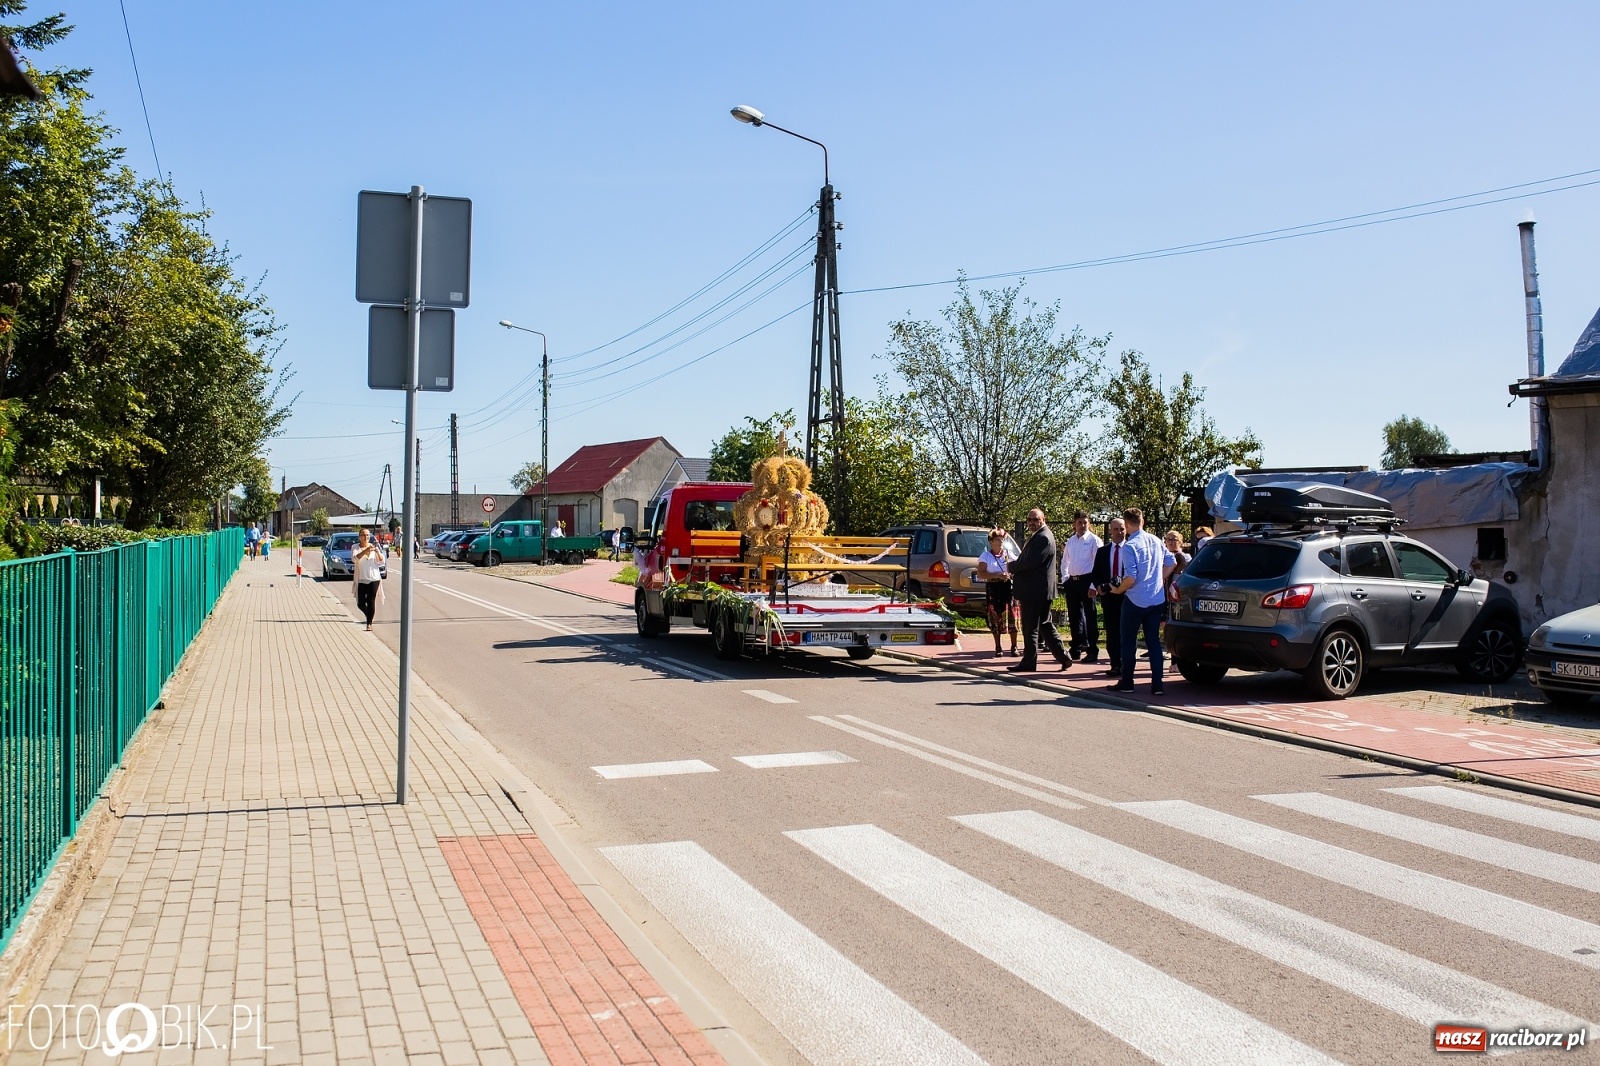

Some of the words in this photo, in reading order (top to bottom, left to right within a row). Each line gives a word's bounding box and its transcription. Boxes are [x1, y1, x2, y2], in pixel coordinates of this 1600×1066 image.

[1199, 600, 1212, 611] SWD
[1214, 602, 1238, 613] 09023
[811, 632, 825, 642] HAM
[829, 632, 838, 642] TP
[839, 632, 852, 641] 444
[1557, 663, 1570, 674] SK
